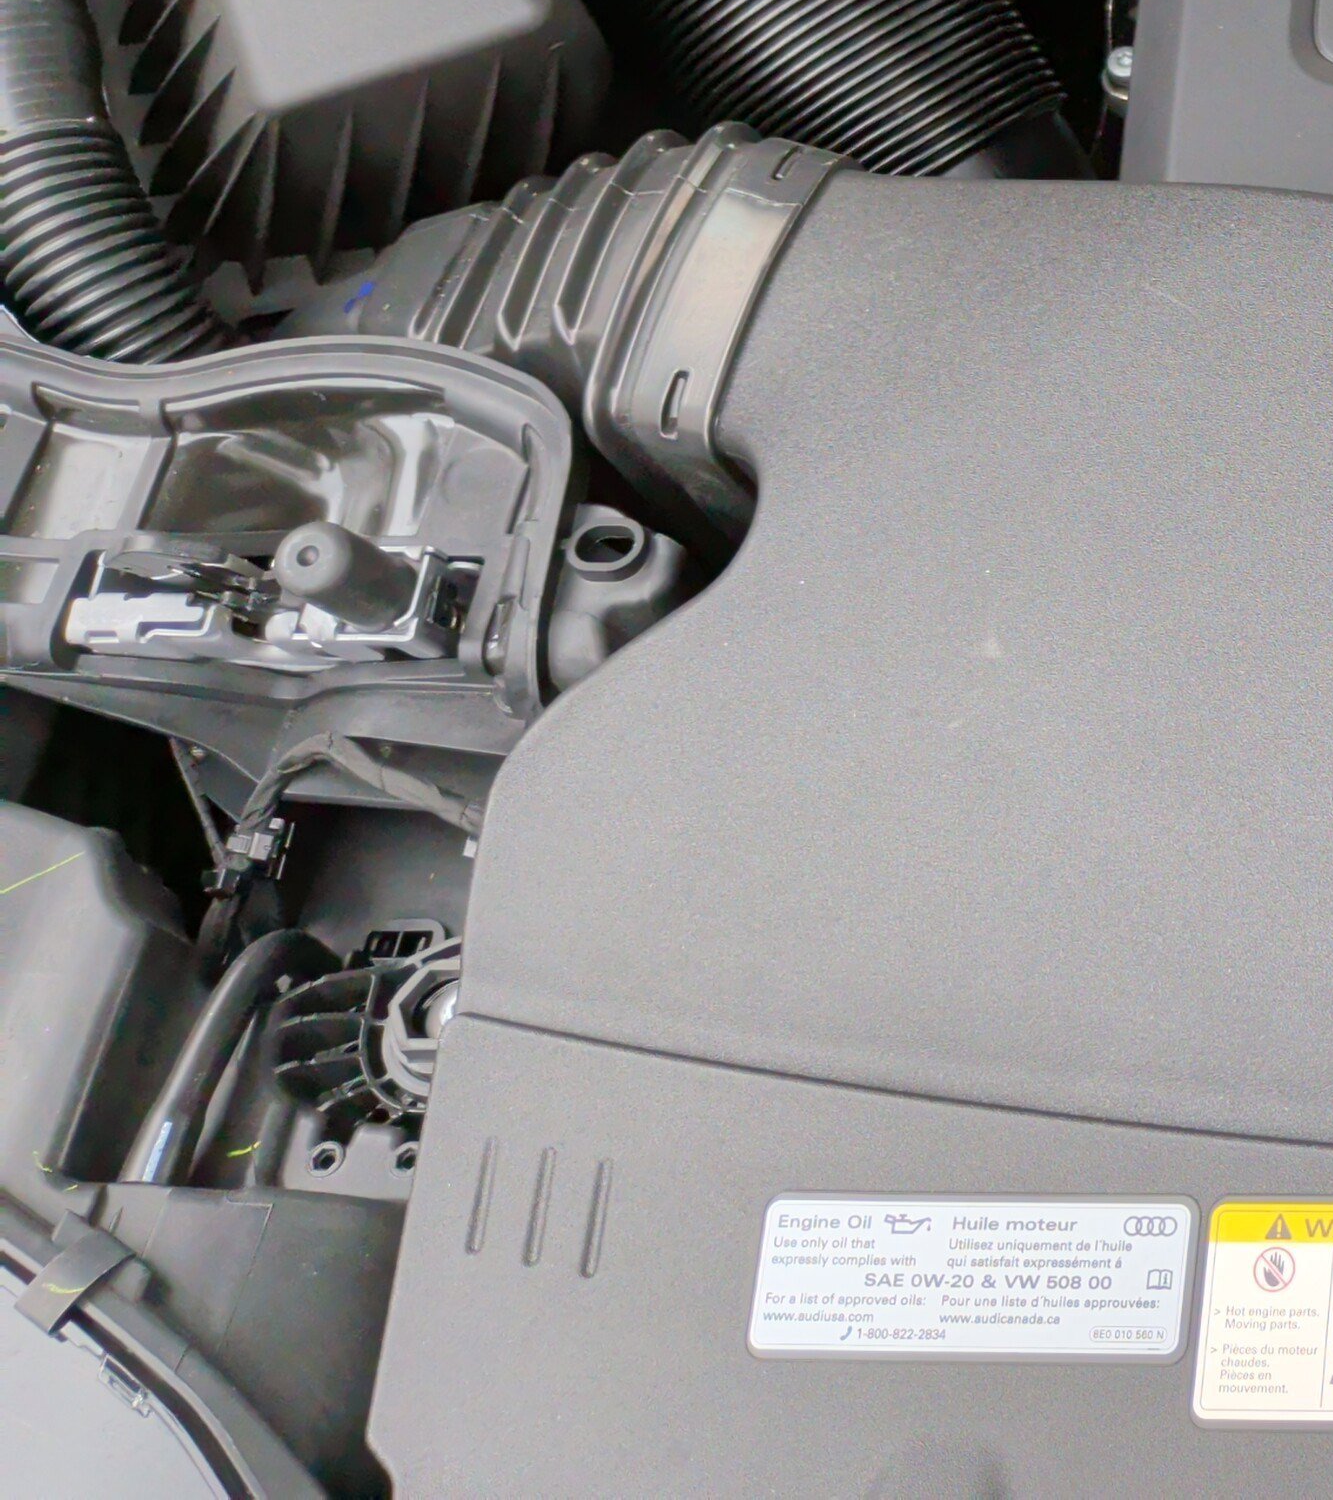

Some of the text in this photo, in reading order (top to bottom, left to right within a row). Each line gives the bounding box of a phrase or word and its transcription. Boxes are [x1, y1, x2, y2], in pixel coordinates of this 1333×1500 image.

[778, 1214, 872, 1231] Engine Oil
[952, 1216, 1077, 1231] Huile moteur
[773, 1237, 875, 1251] Use only oil that
[949, 1238, 993, 1251] Utilisez
[997, 1240, 1072, 1253] uniquement
[1076, 1240, 1090, 1252] de
[771, 1254, 917, 1267] expressly complies with
[947, 1256, 967, 1270] qui
[970, 1255, 1019, 1268] satisfait
[1023, 1255, 1111, 1270] expressément
[864, 1273, 905, 1288] SAE
[981, 1274, 997, 1289] &
[1005, 1275, 1040, 1289] VW
[1047, 1275, 1082, 1290] 508
[1088, 1276, 1112, 1290] 00
[765, 1292, 926, 1307] For a list of approved oils:
[941, 1295, 971, 1307] Pour
[974, 1297, 998, 1307] une
[1001, 1295, 1027, 1307] liste
[763, 1310, 875, 1322] www.audiusa.com
[1225, 1305, 1246, 1317] Hot
[1248, 1306, 1286, 1318] engine
[938, 1313, 1061, 1325] www.audicanada.ca
[1225, 1318, 1267, 1331] Moving
[857, 1328, 946, 1340] 1-800-822-2834
[1114, 1329, 1132, 1339] 010
[1260, 1344, 1274, 1355] du
[1277, 1345, 1318, 1356] moteur
[1258, 1371, 1272, 1380] en
